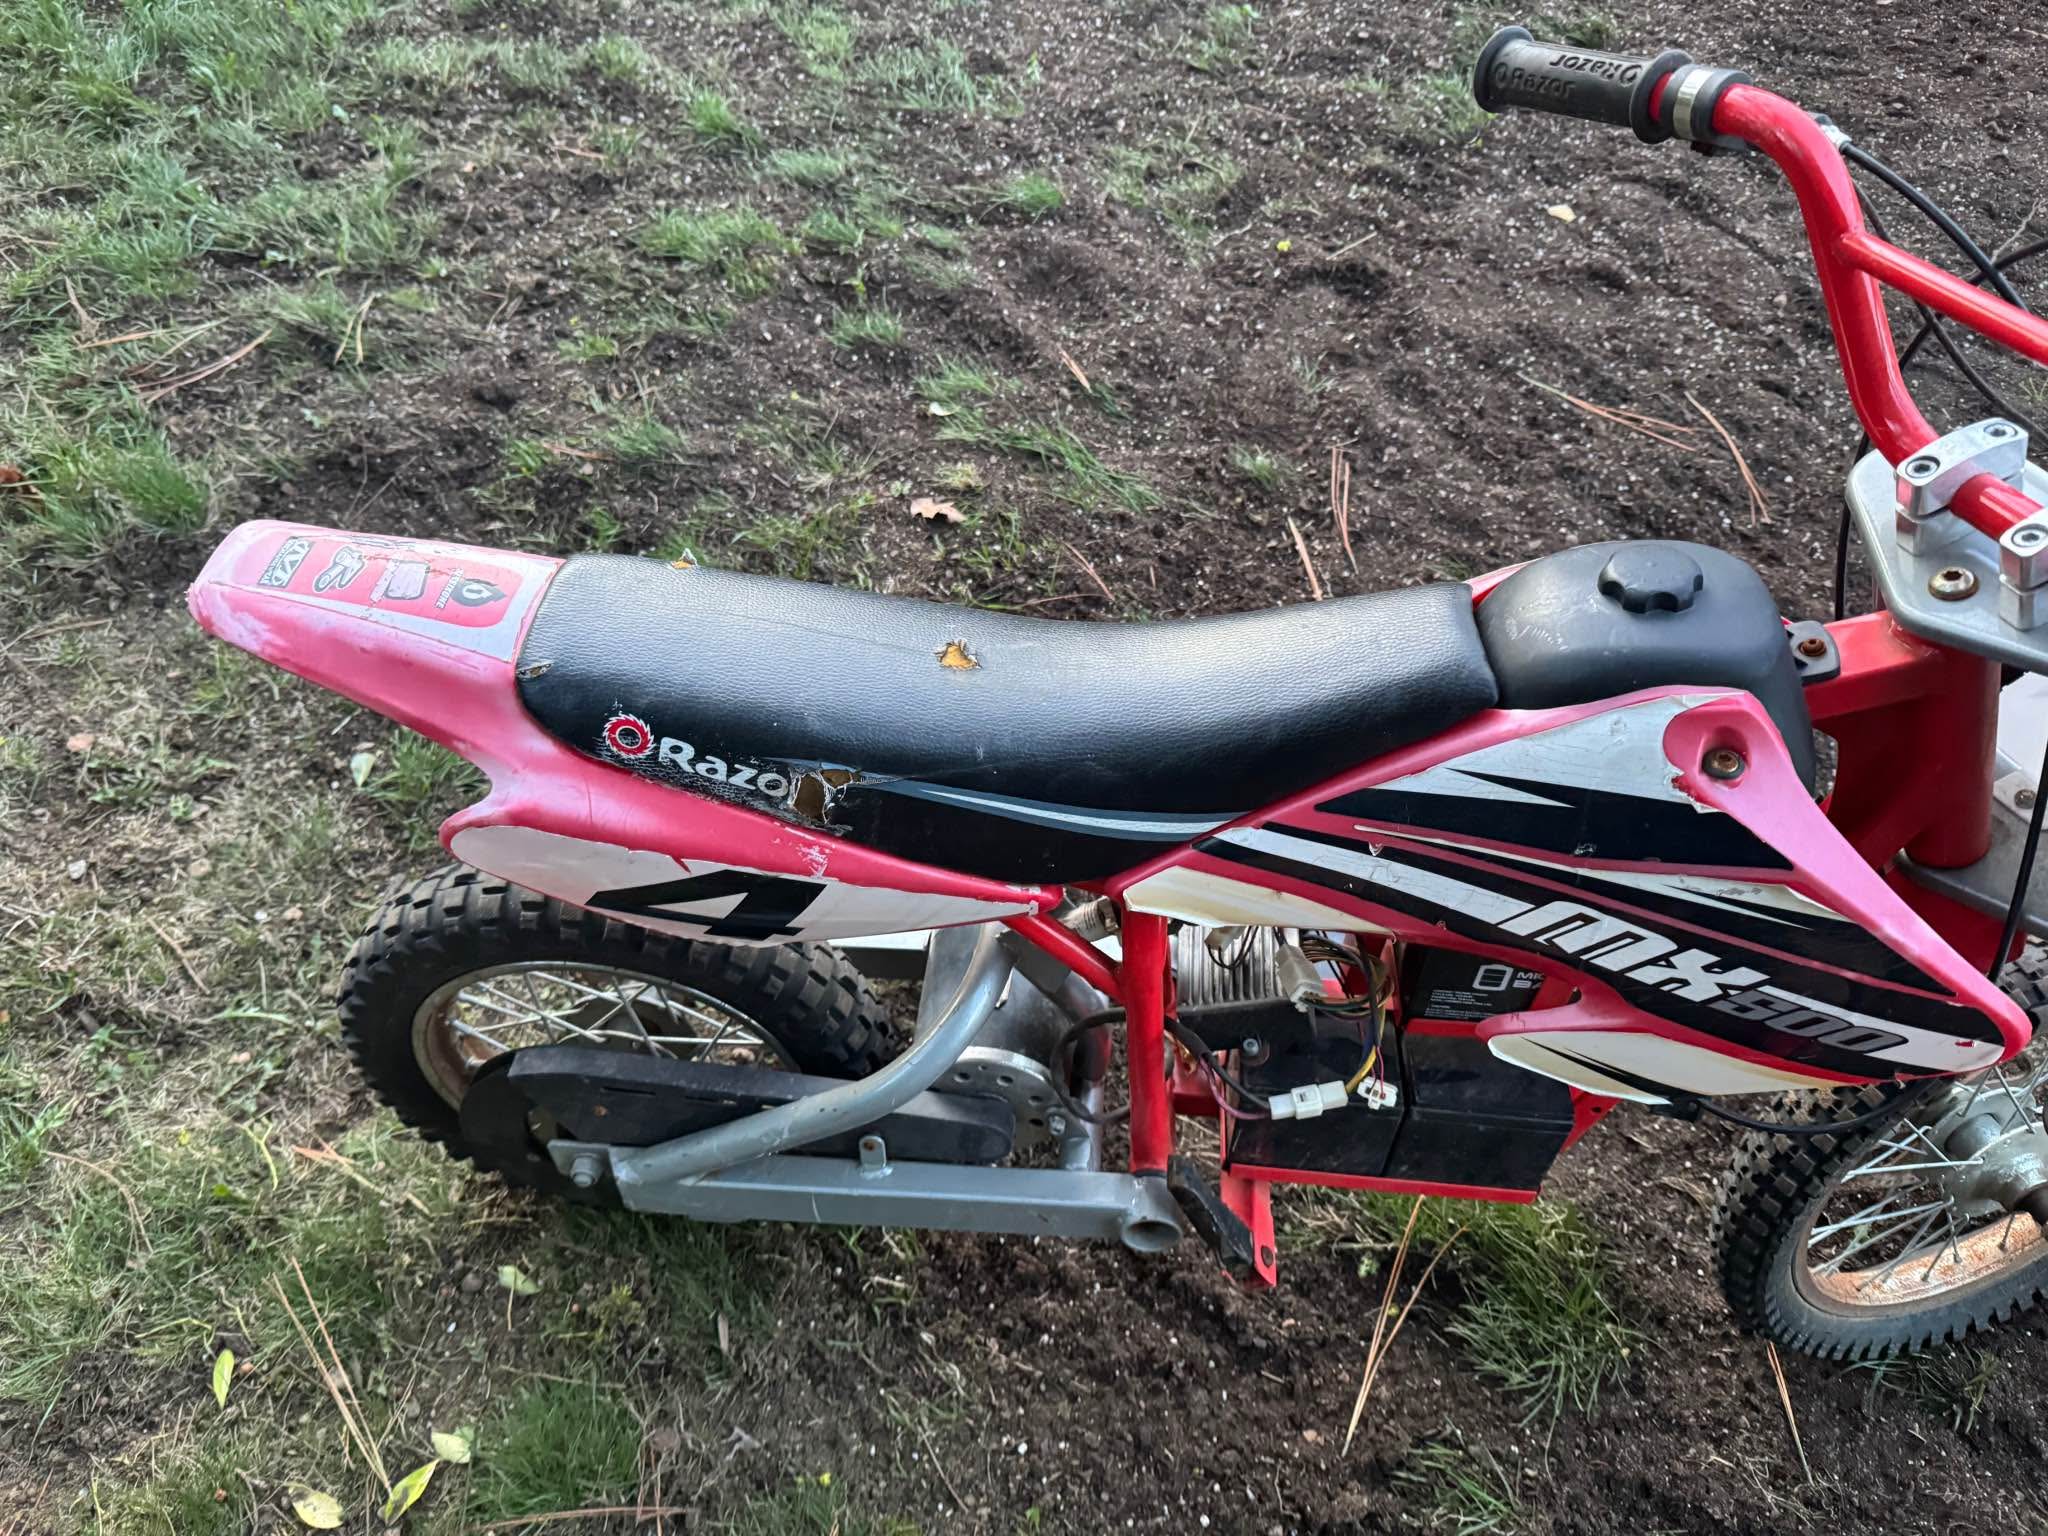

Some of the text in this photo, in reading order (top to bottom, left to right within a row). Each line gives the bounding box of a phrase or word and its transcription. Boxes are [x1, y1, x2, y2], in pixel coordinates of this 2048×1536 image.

[1550, 54, 1622, 80] Razor
[658, 736, 789, 797] Razo
[585, 869, 828, 940] 4
